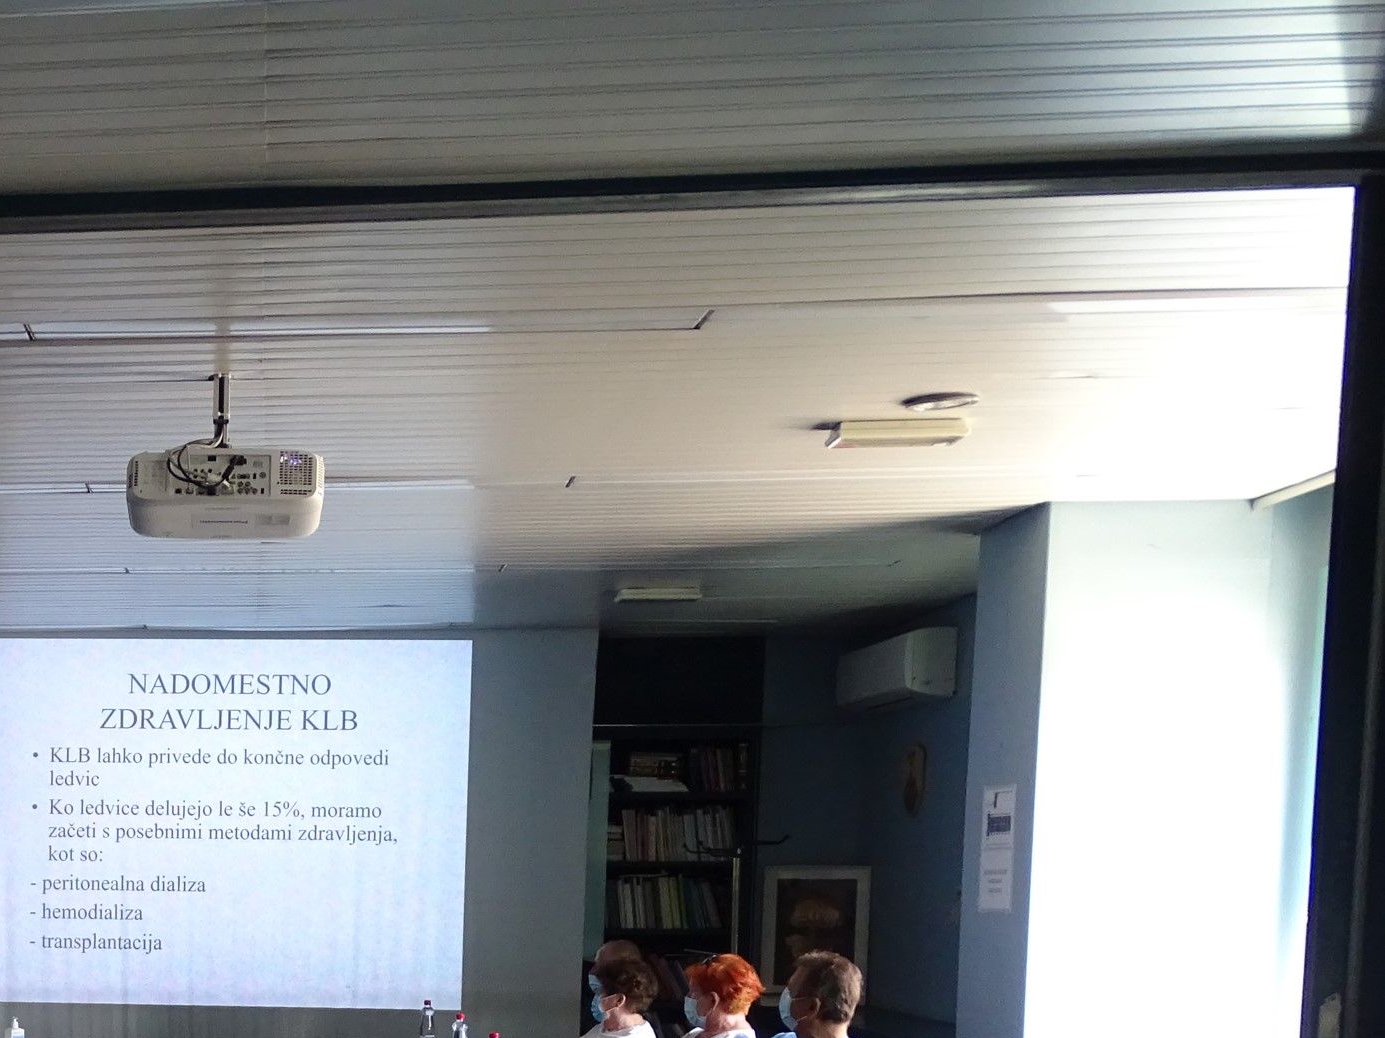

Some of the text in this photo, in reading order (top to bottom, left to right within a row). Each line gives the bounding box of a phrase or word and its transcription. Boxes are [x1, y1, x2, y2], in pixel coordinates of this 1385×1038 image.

[127, 673, 332, 696] NADOMESTNO
[99, 708, 358, 731] ZDRAVLJENJE KLB
[49, 746, 389, 770] KLB lahko privede do končne odpovedi
[49, 769, 100, 787] ledvic
[48, 798, 382, 821] Ko ledvice delujejo le še 15%, moramo
[48, 821, 398, 846] začeti s posebnimi metodami zdravljenja,
[48, 844, 103, 863] kot so:
[41, 873, 145, 895] peritonealna
[150, 874, 207, 893] dializa
[40, 902, 144, 921] hemodializa
[41, 932, 163, 955] transplantacija
